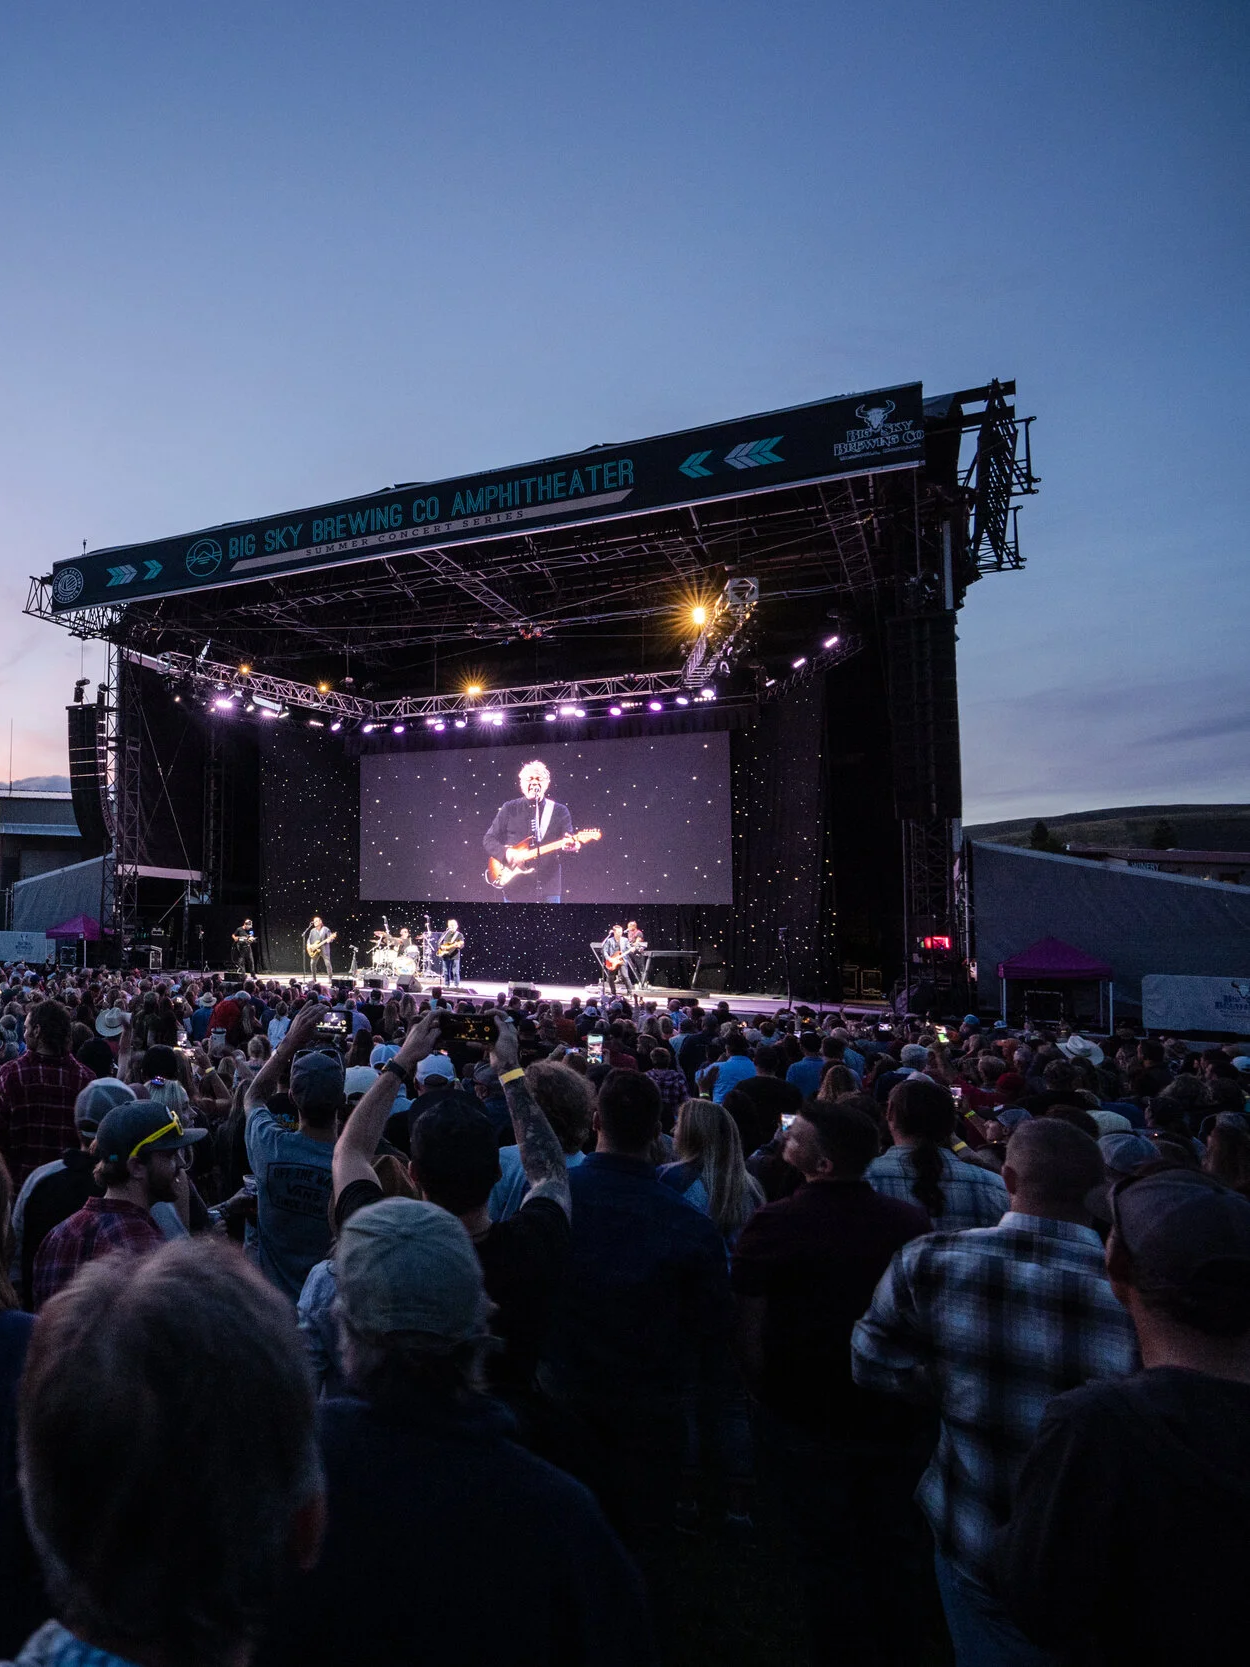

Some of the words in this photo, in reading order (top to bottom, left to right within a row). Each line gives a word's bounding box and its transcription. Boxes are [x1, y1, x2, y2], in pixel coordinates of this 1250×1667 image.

[228, 533, 256, 560] BIG
[264, 523, 304, 552] SKY
[312, 503, 403, 543] BREWING
[412, 495, 440, 523] CO
[451, 458, 635, 518] AMPHITHEATER
[306, 538, 368, 556] SUMMER
[378, 523, 452, 543] CONCERT
[462, 510, 524, 528] SERIES
